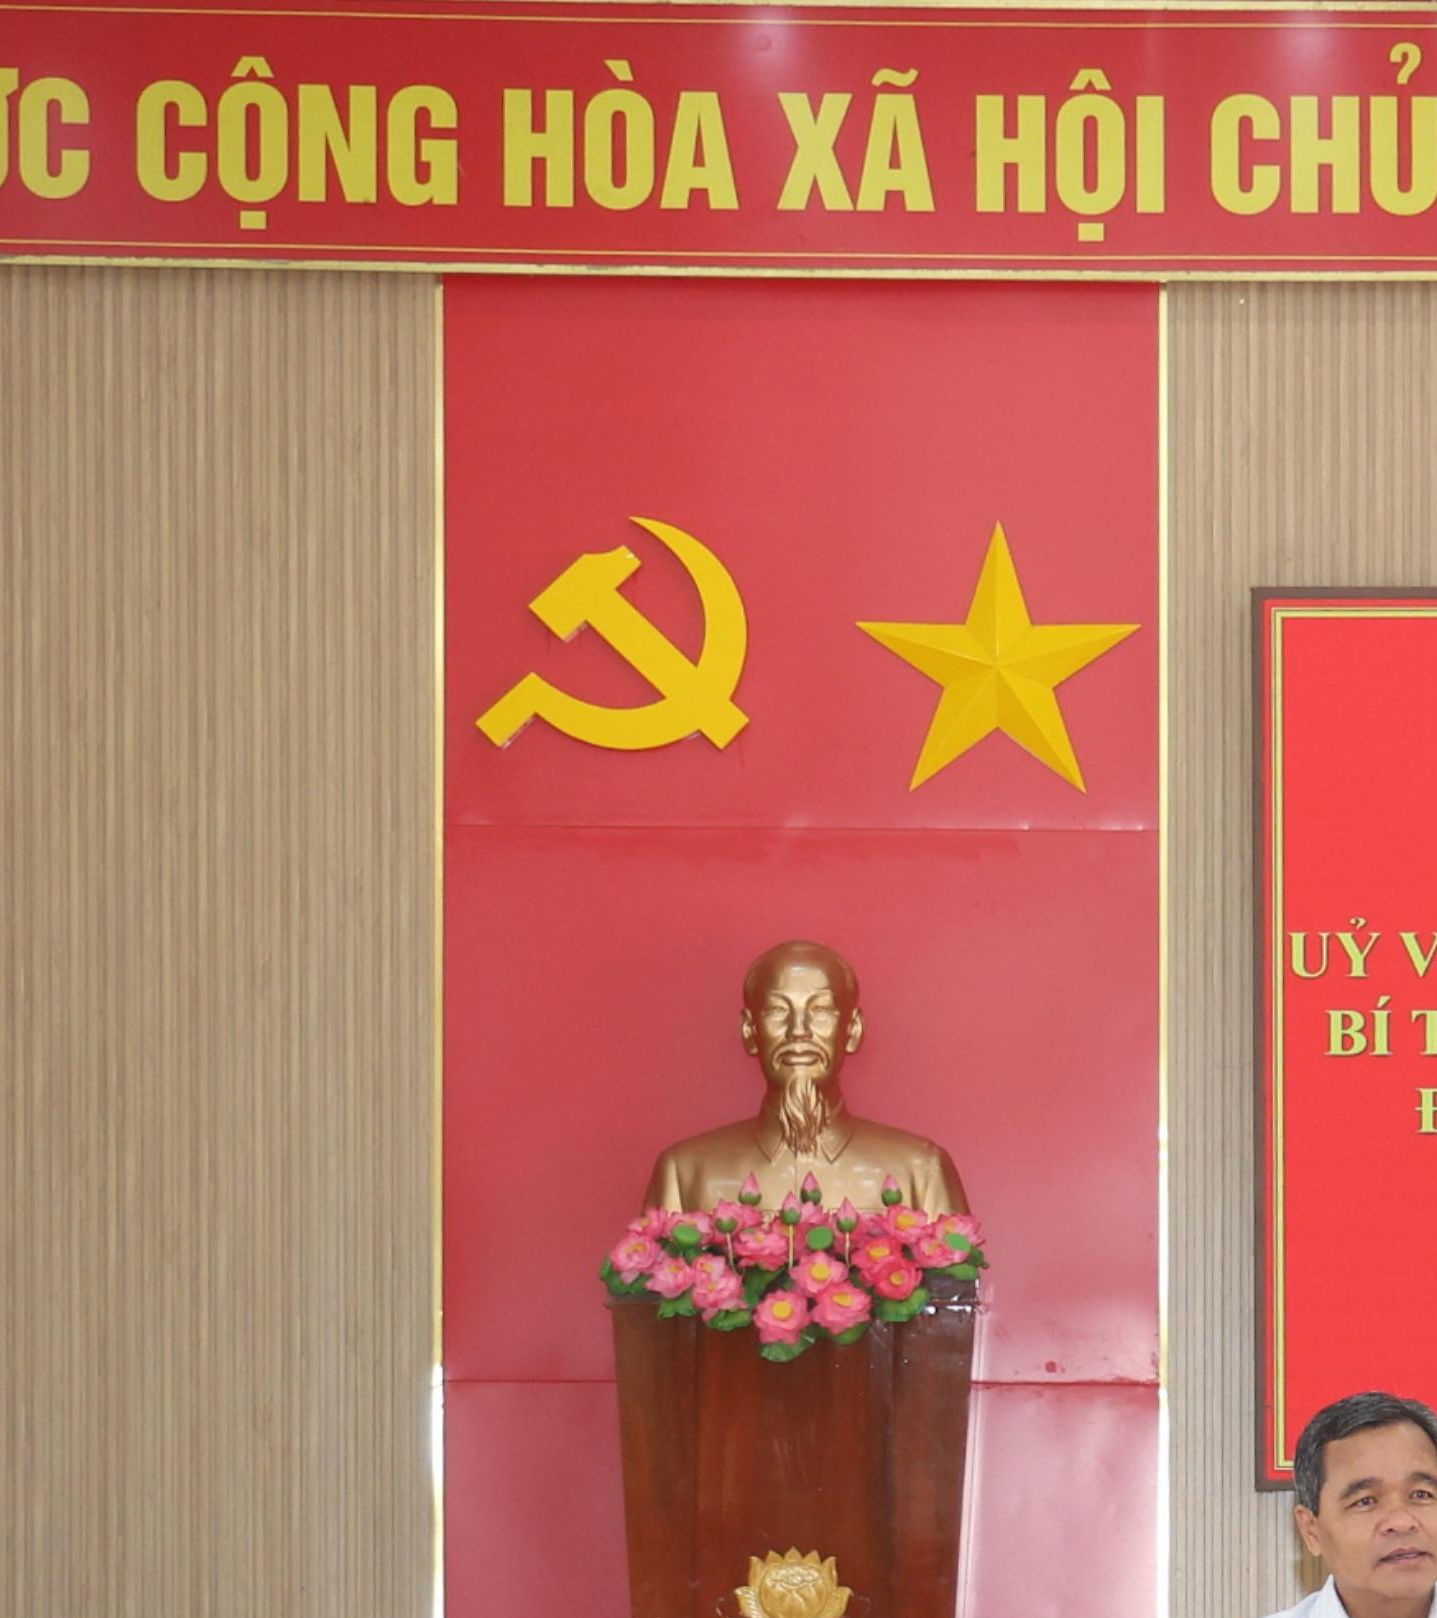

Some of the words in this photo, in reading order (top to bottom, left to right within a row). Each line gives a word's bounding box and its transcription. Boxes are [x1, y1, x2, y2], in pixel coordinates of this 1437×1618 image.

[137, 56, 457, 229] CỘNG
[504, 60, 738, 209] HÒA
[778, 68, 934, 212] XÃ
[976, 68, 1165, 241] HỘI
[1329, 995, 1390, 1055] BÍ
